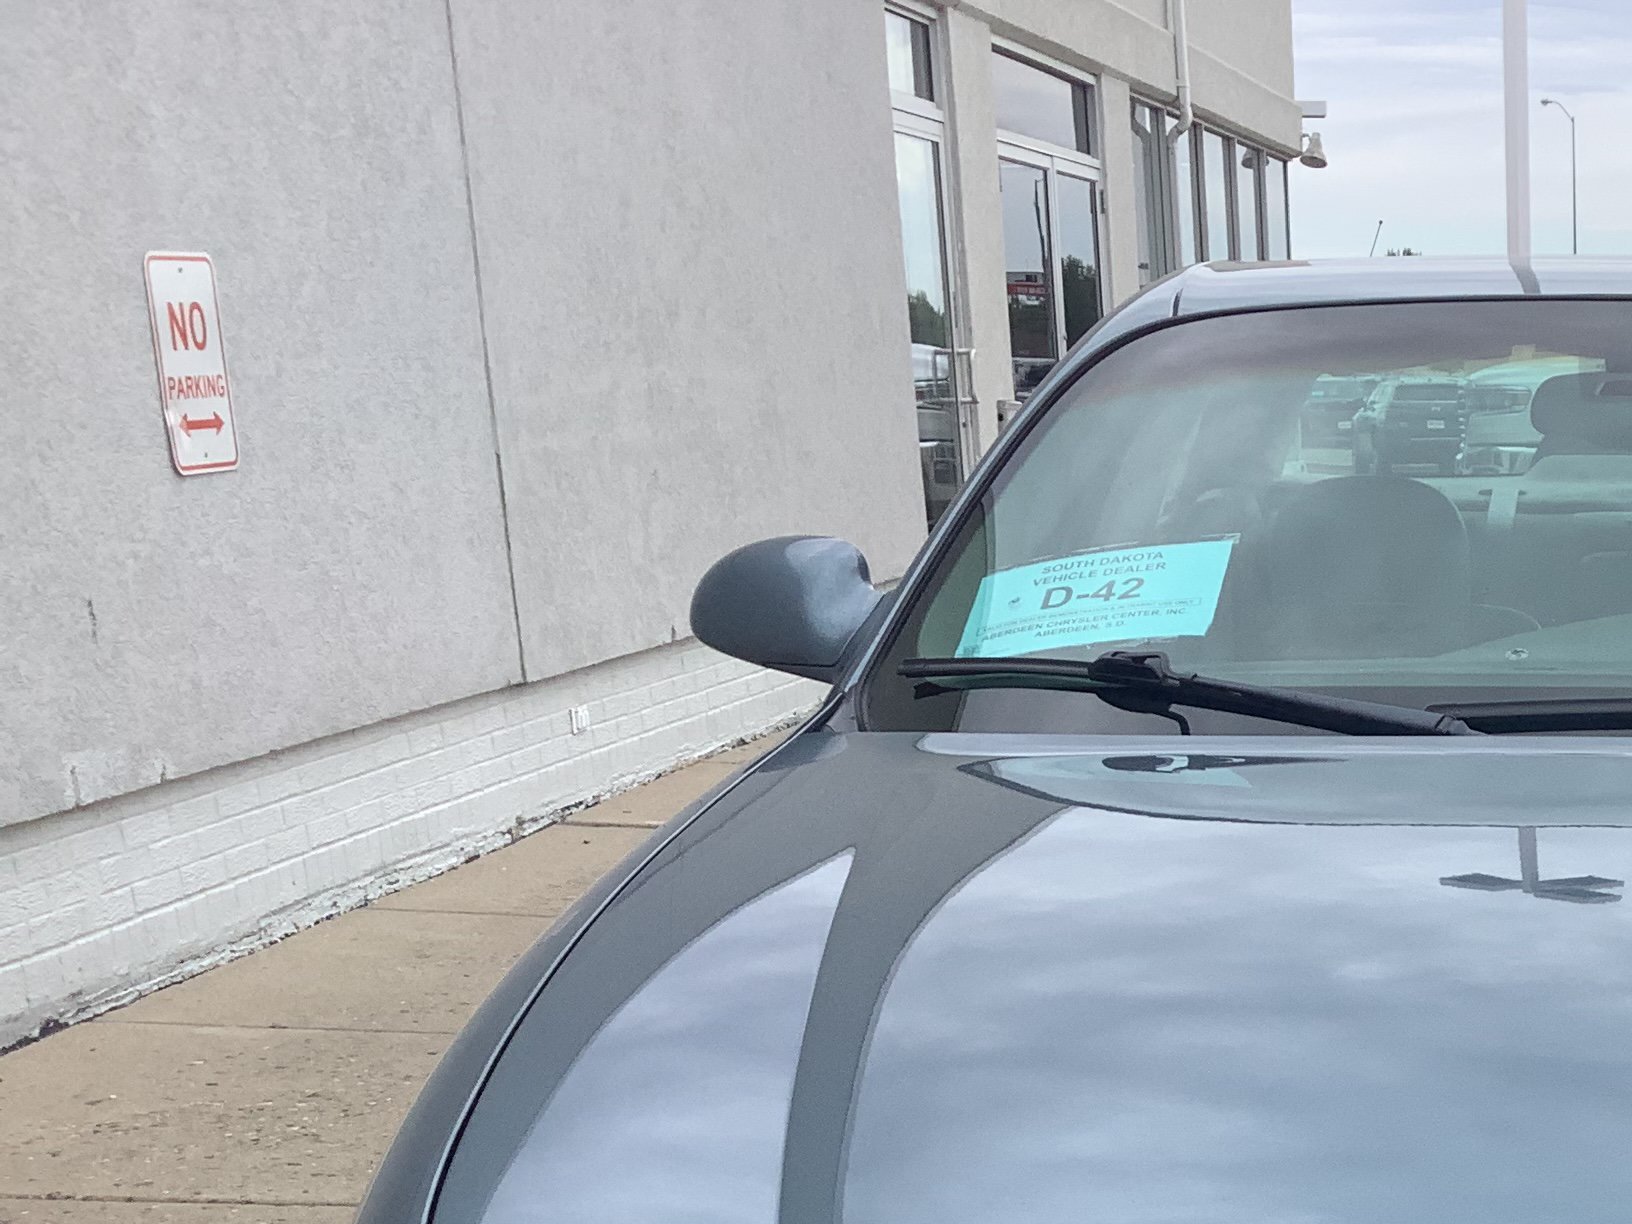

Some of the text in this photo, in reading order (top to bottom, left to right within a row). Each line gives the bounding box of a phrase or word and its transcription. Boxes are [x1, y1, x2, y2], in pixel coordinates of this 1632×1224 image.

[167, 302, 207, 350] NO
[167, 374, 226, 400] PARKING
[1033, 562, 1167, 587] VEHICLE DEALER
[1042, 551, 1164, 574] SOUTH DAKOTA
[1040, 577, 1145, 610] D-42
[981, 622, 1043, 641] ABERDEEN
[1046, 614, 1108, 629] CHRYSLER
